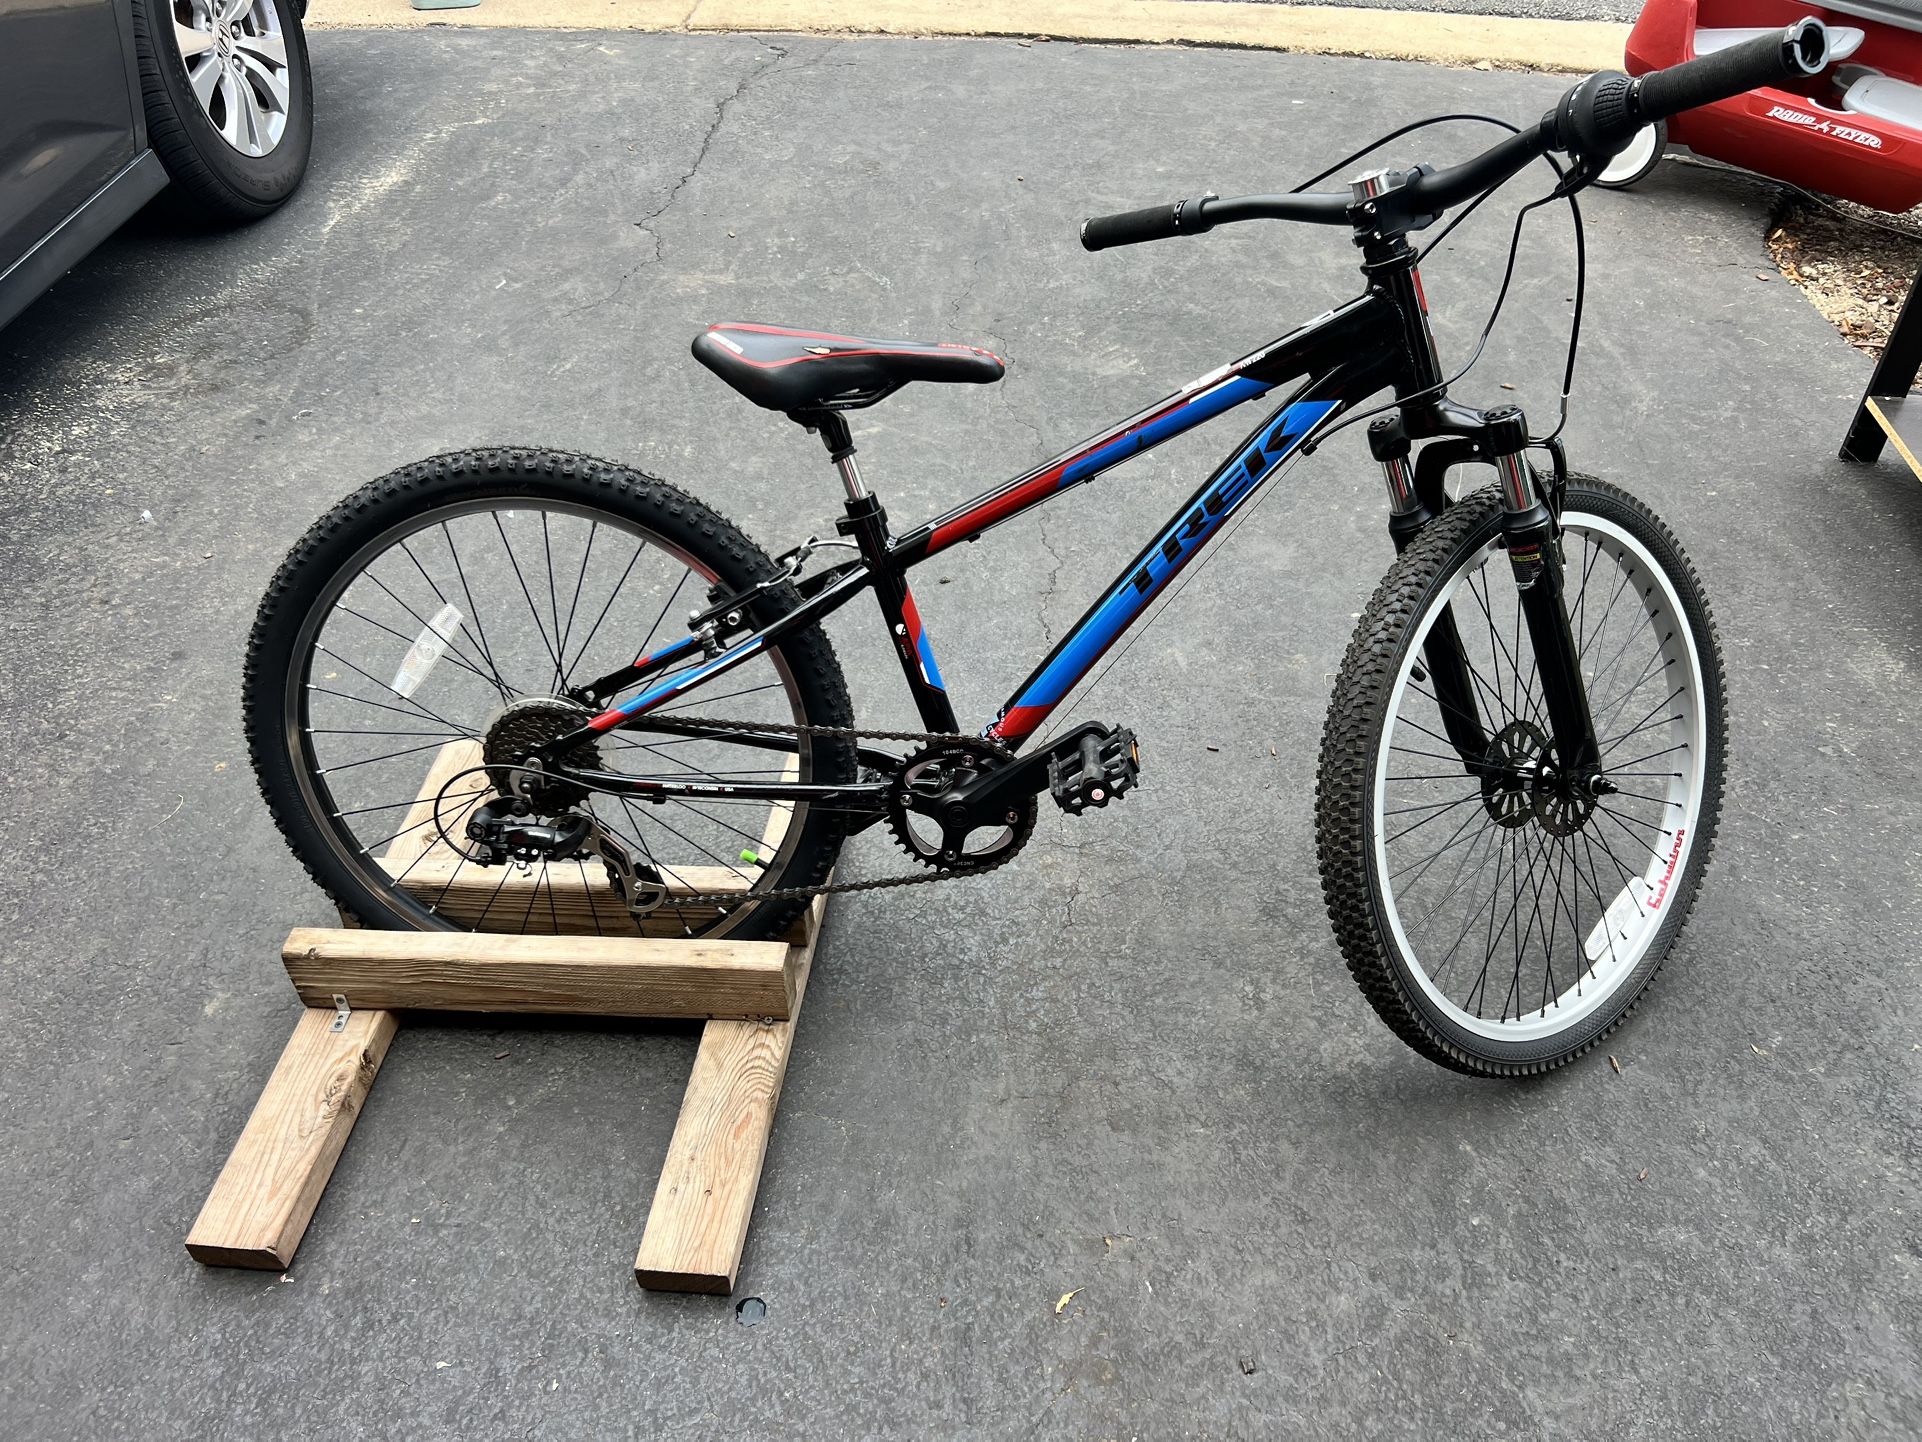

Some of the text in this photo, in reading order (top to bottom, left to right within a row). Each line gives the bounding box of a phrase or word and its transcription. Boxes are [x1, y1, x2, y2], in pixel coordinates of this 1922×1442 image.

[1766, 105, 1883, 149] RADIO FLYER
[1118, 414, 1299, 596] TREK
